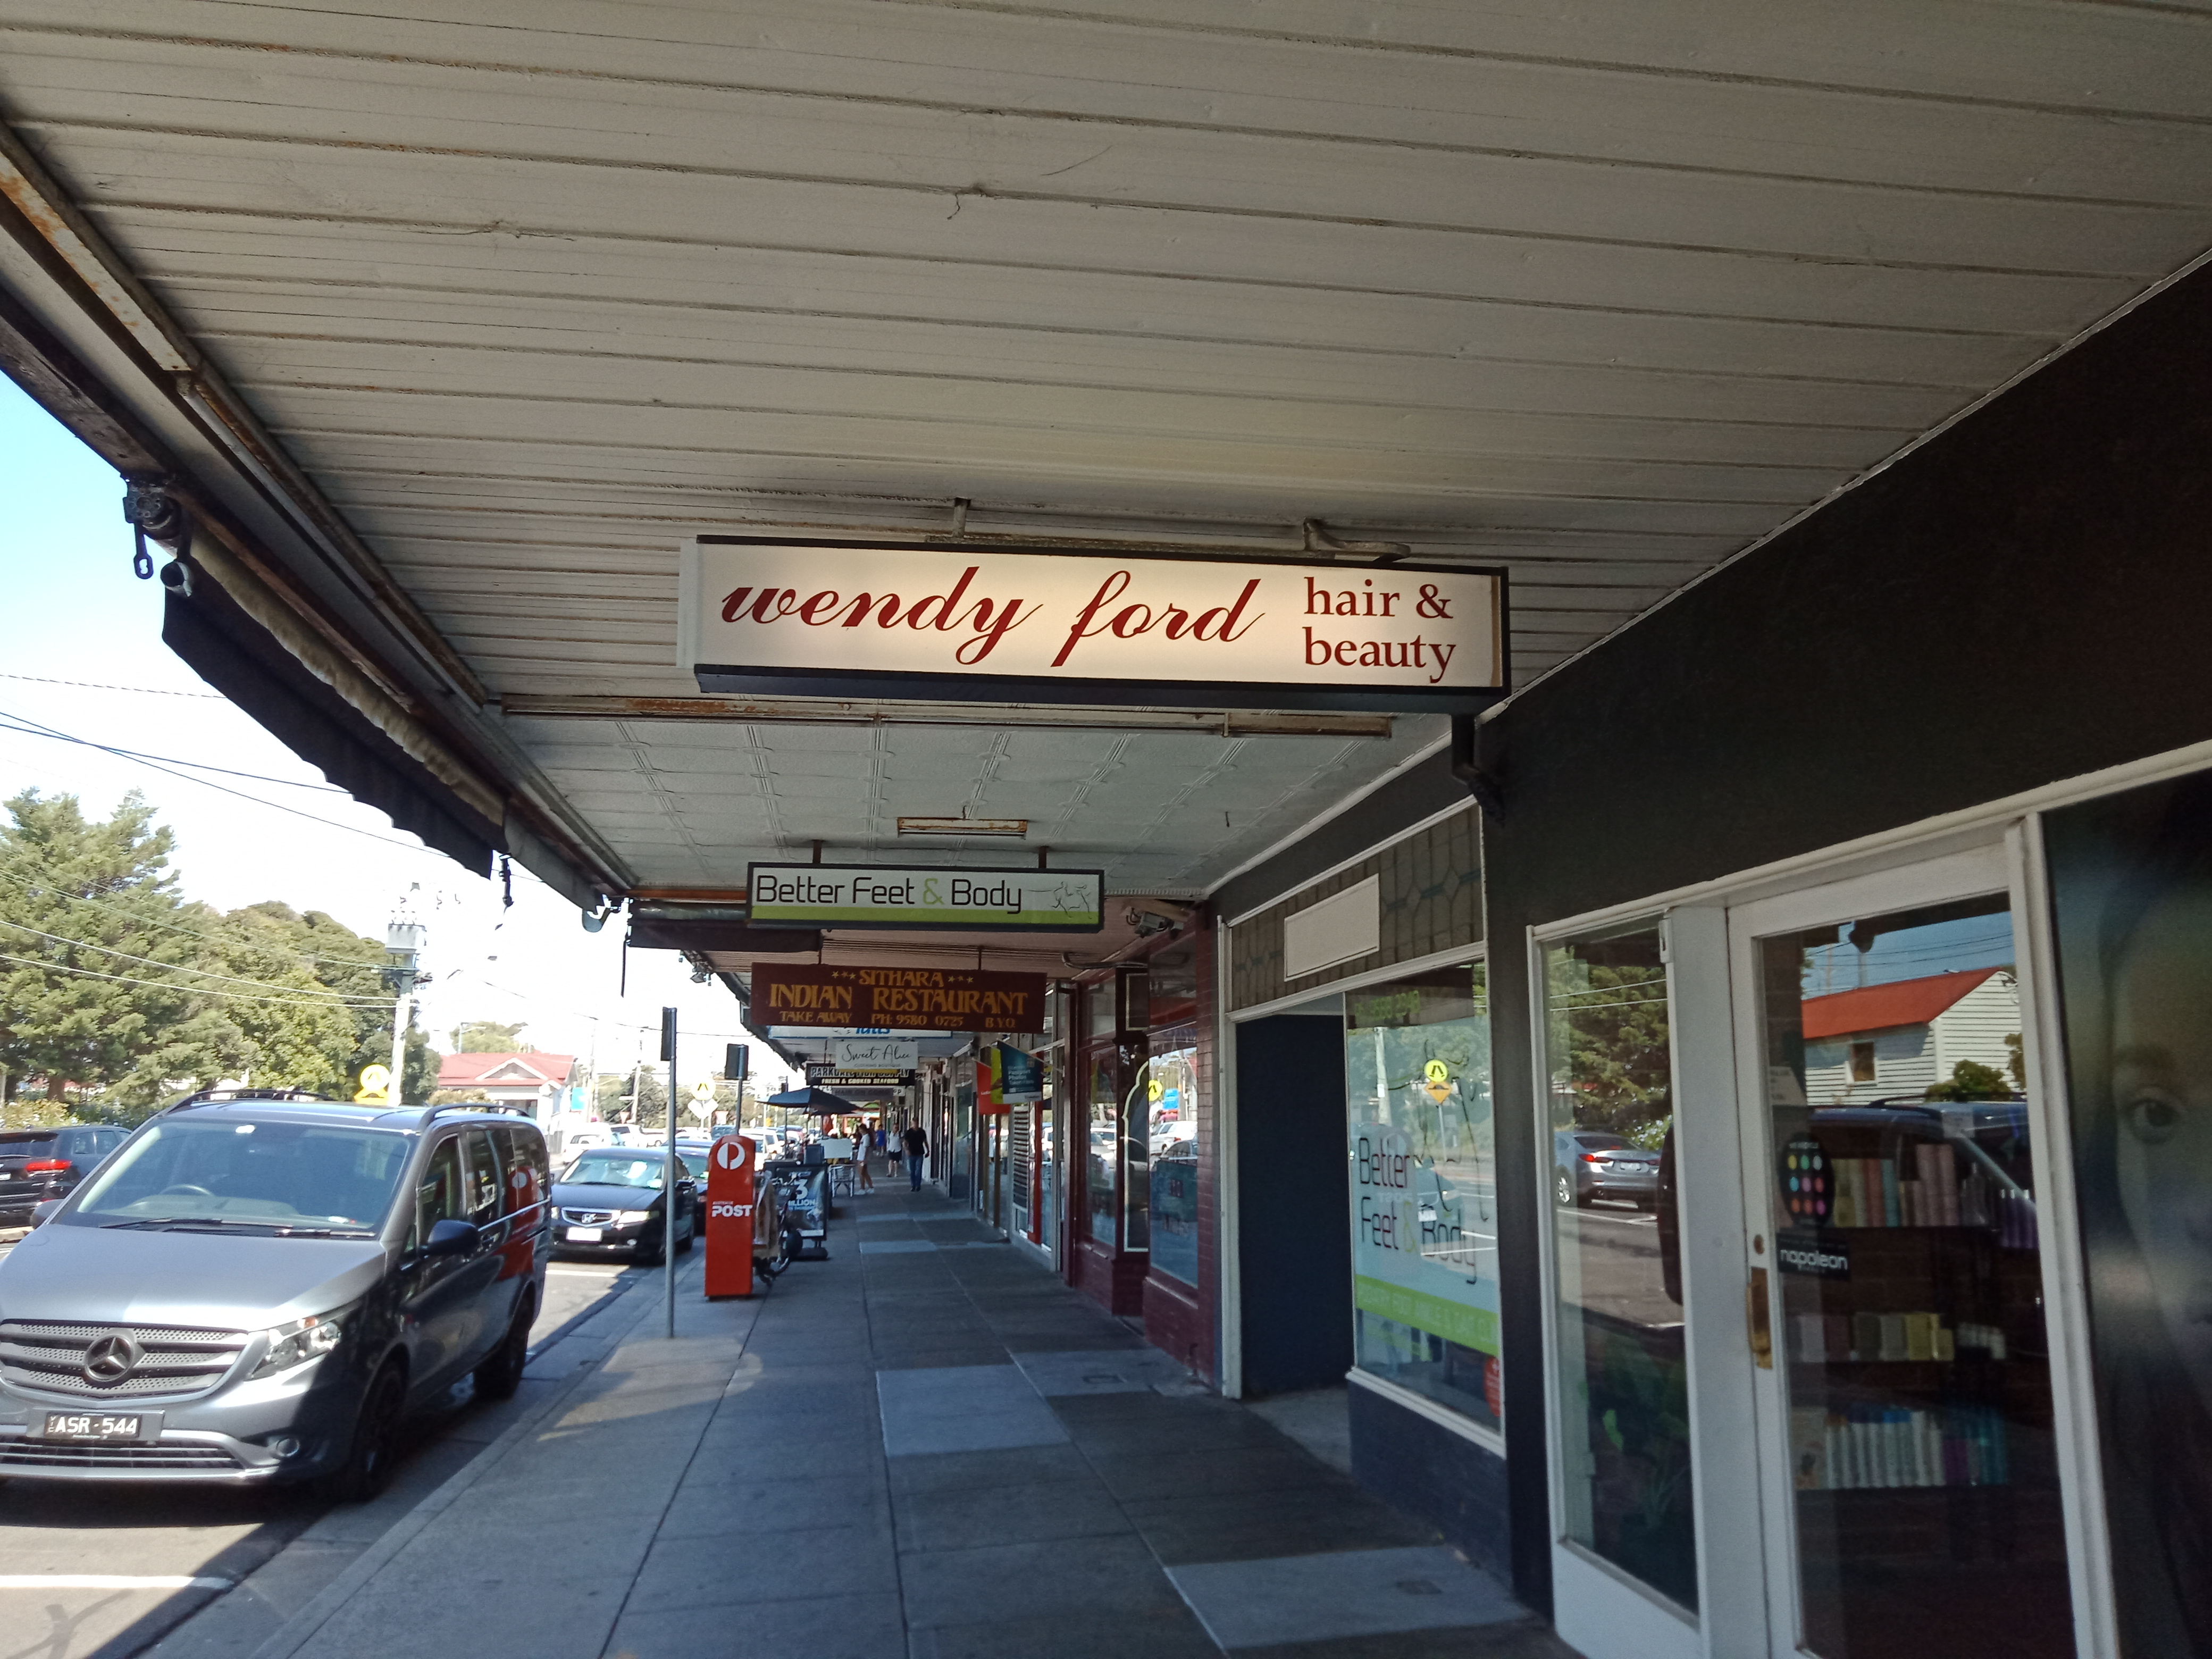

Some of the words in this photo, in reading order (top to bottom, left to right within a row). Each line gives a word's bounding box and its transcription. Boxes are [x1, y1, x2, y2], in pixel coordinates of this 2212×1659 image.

[1303, 576, 1400, 617] hair
[1417, 584, 1454, 618] &
[721, 566, 1044, 665] wendy
[1050, 569, 1266, 667] ford
[1303, 626, 1456, 682] beauty
[757, 875, 845, 903] Better
[852, 877, 915, 904] Feet
[923, 878, 944, 904] &
[951, 879, 1021, 914] Body
[859, 970, 944, 987] SITHARA
[769, 984, 851, 1009] INDIAN
[873, 988, 1028, 1015] RESTAURANT
[780, 1010, 814, 1023] TAKE
[817, 1012, 851, 1024] AWAY
[896, 1015, 927, 1026] 9580
[935, 1016, 963, 1027] 0725
[842, 1043, 881, 1062] Sweet
[1359, 1137, 1410, 1189] Better
[794, 1179, 808, 1200] 3
[711, 1204, 753, 1218] POST
[1361, 1196, 1400, 1250] Feet
